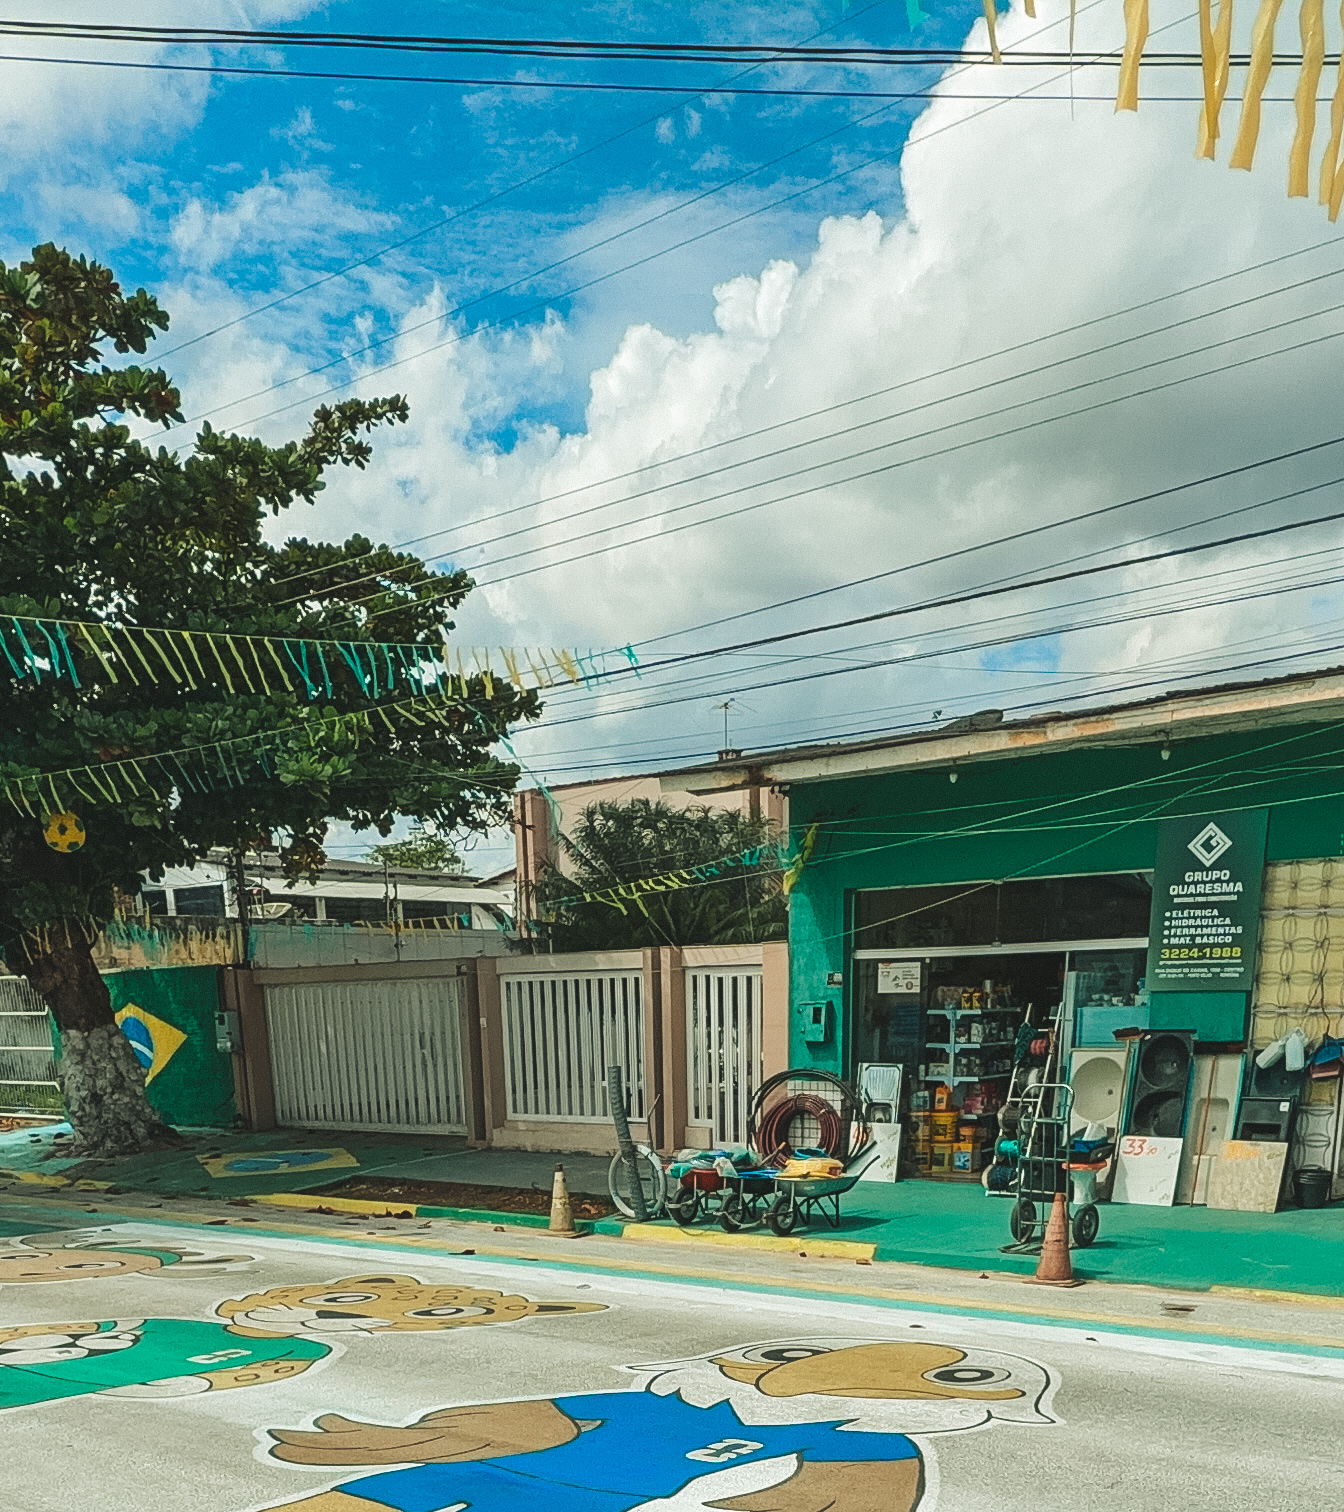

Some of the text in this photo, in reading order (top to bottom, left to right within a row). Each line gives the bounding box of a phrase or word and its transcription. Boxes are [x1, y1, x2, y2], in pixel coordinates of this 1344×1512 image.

[1184, 870, 1230, 882] GRUPO
[1169, 882, 1243, 895] QUARESMA
[1172, 909, 1219, 917] ELÉTRICA
[1171, 917, 1231, 926] HIDRÁULICA
[1170, 926, 1243, 935] FERRAMENTAS
[1195, 935, 1233, 944] BÁSICO
[1160, 947, 1242, 958] 3224-1988
